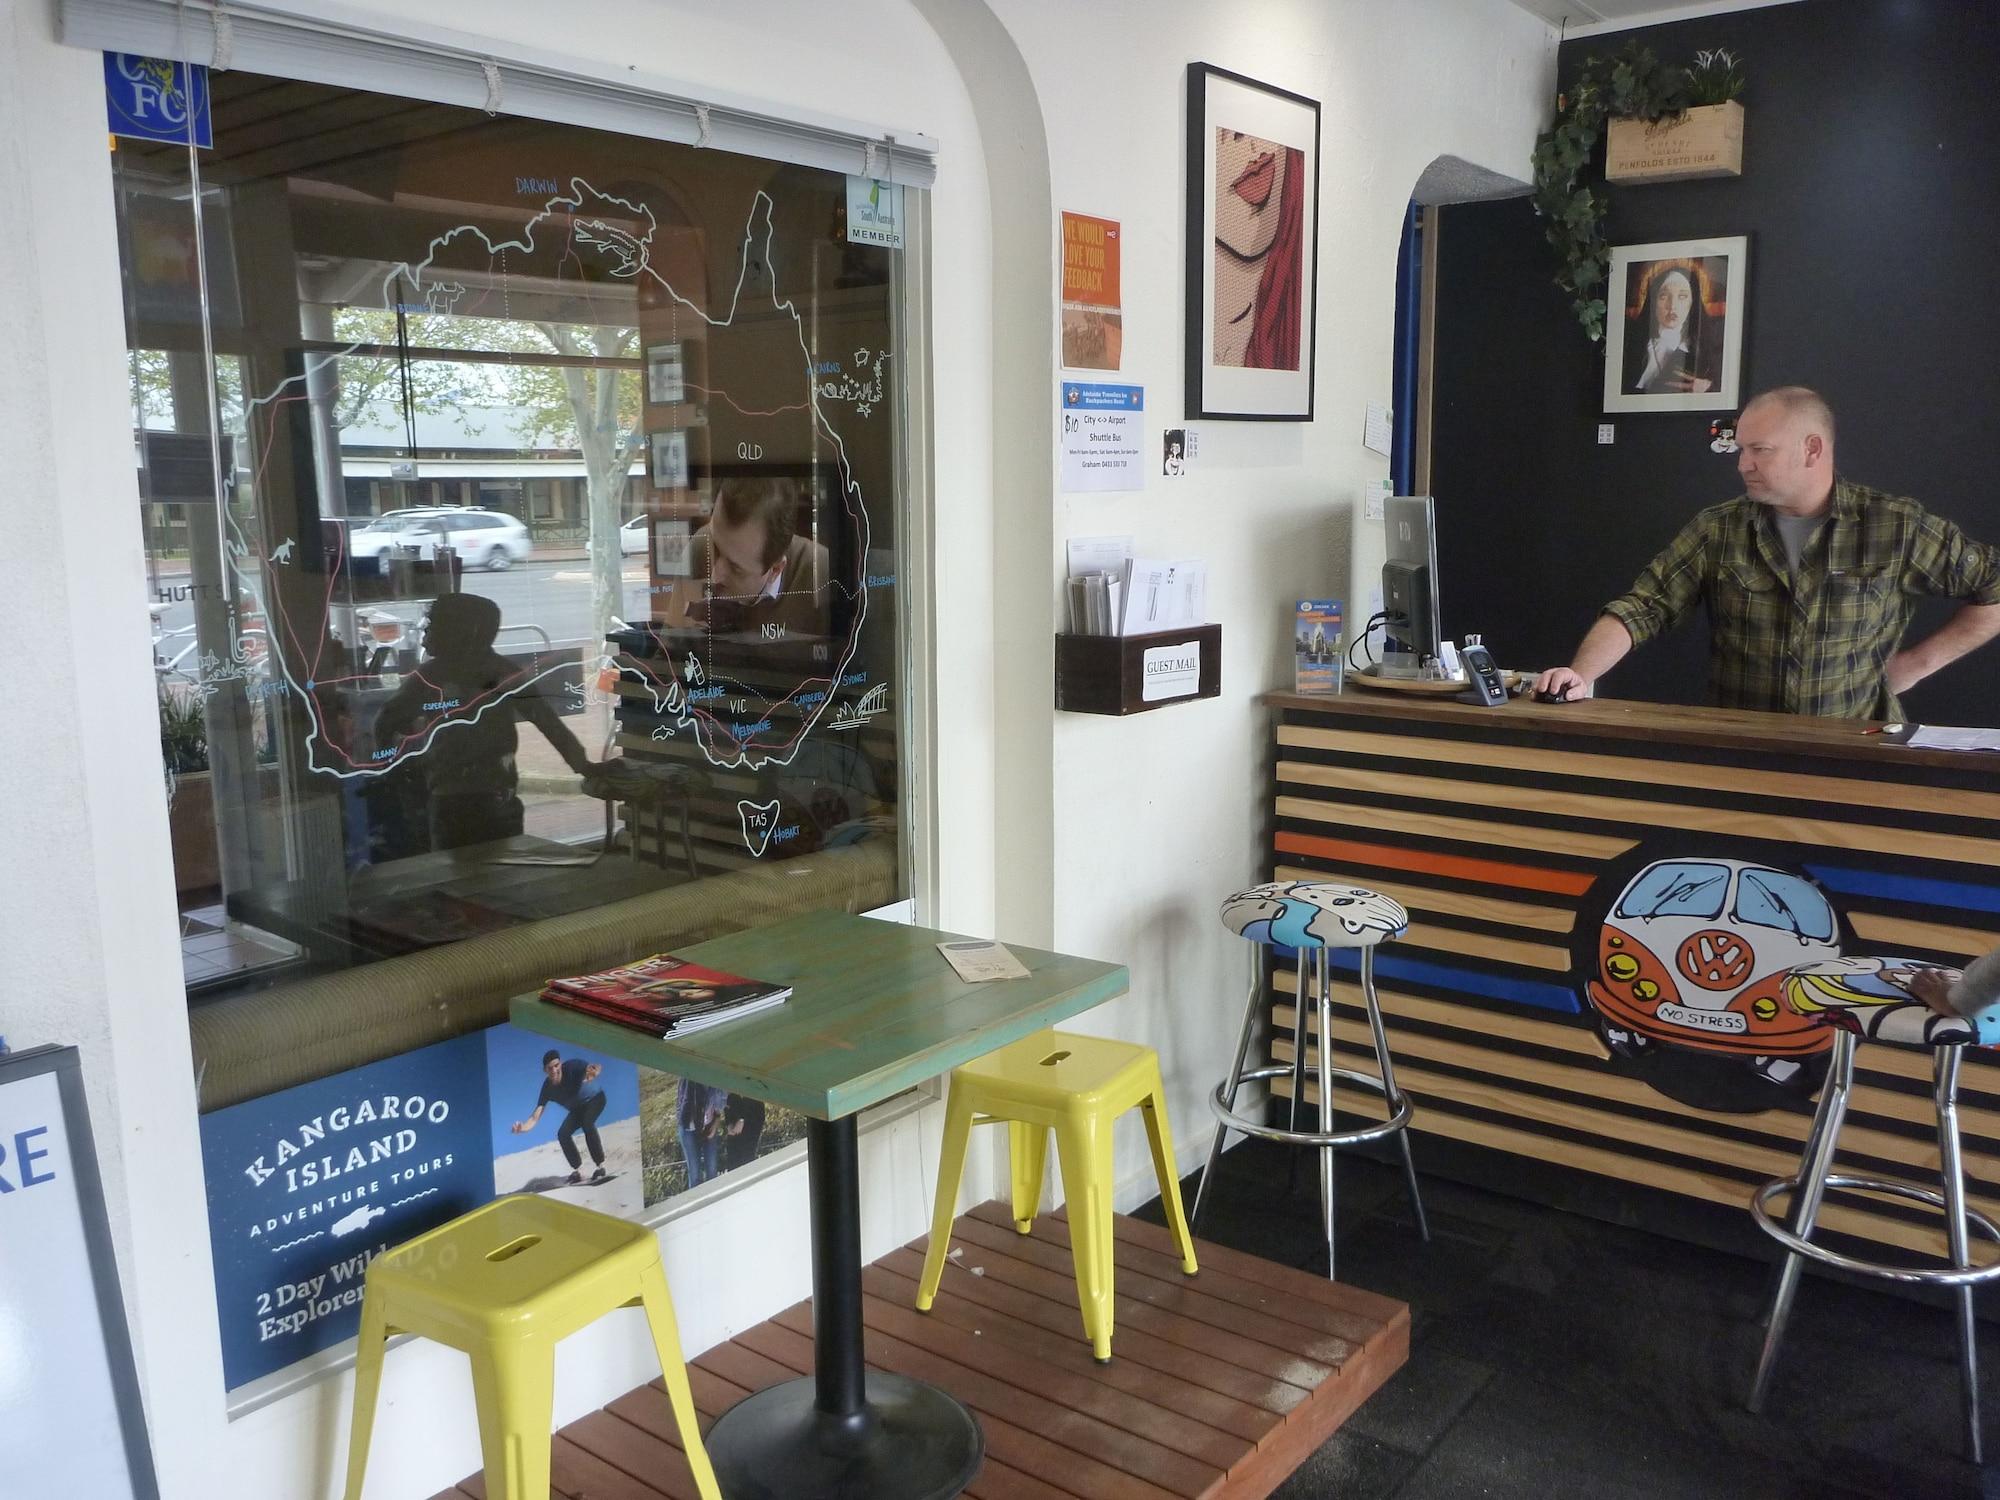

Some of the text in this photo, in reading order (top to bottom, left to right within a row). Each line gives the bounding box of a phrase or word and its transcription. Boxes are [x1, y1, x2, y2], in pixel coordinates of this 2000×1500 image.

[129, 81, 188, 124] FC
[515, 177, 559, 194] DARWIN
[852, 229, 900, 244] MEMBER
[1063, 217, 1105, 247] WE WOULD
[1064, 242, 1106, 270] LOVE YOUR
[1063, 266, 1103, 293] FEEDBACK
[1065, 414, 1079, 433] $10
[1083, 415, 1096, 426] City
[1108, 415, 1126, 426] Airport
[1089, 432, 1122, 442] Shuttle Bus
[737, 441, 763, 461] QLD
[761, 622, 786, 640] NSW
[1147, 656, 1197, 674] GUEST MAIL
[842, 671, 868, 687] SYDNEY
[687, 685, 727, 703] ADELAIDE
[730, 699, 747, 714] VIC
[731, 719, 773, 741] MELBOURNE
[371, 746, 400, 762] ALBANY
[748, 813, 767, 828] TAS
[773, 825, 801, 846] HOBART
[555, 958, 670, 989] FINGER
[1660, 1007, 1743, 1029] NO STRESS
[245, 1095, 450, 1187] KANGAROO
[0, 1125, 56, 1194] E
[286, 1128, 418, 1193] ISLAND
[250, 1153, 455, 1238] ADVENTURE TOURS
[256, 1243, 387, 1316] 2 Day Wil
